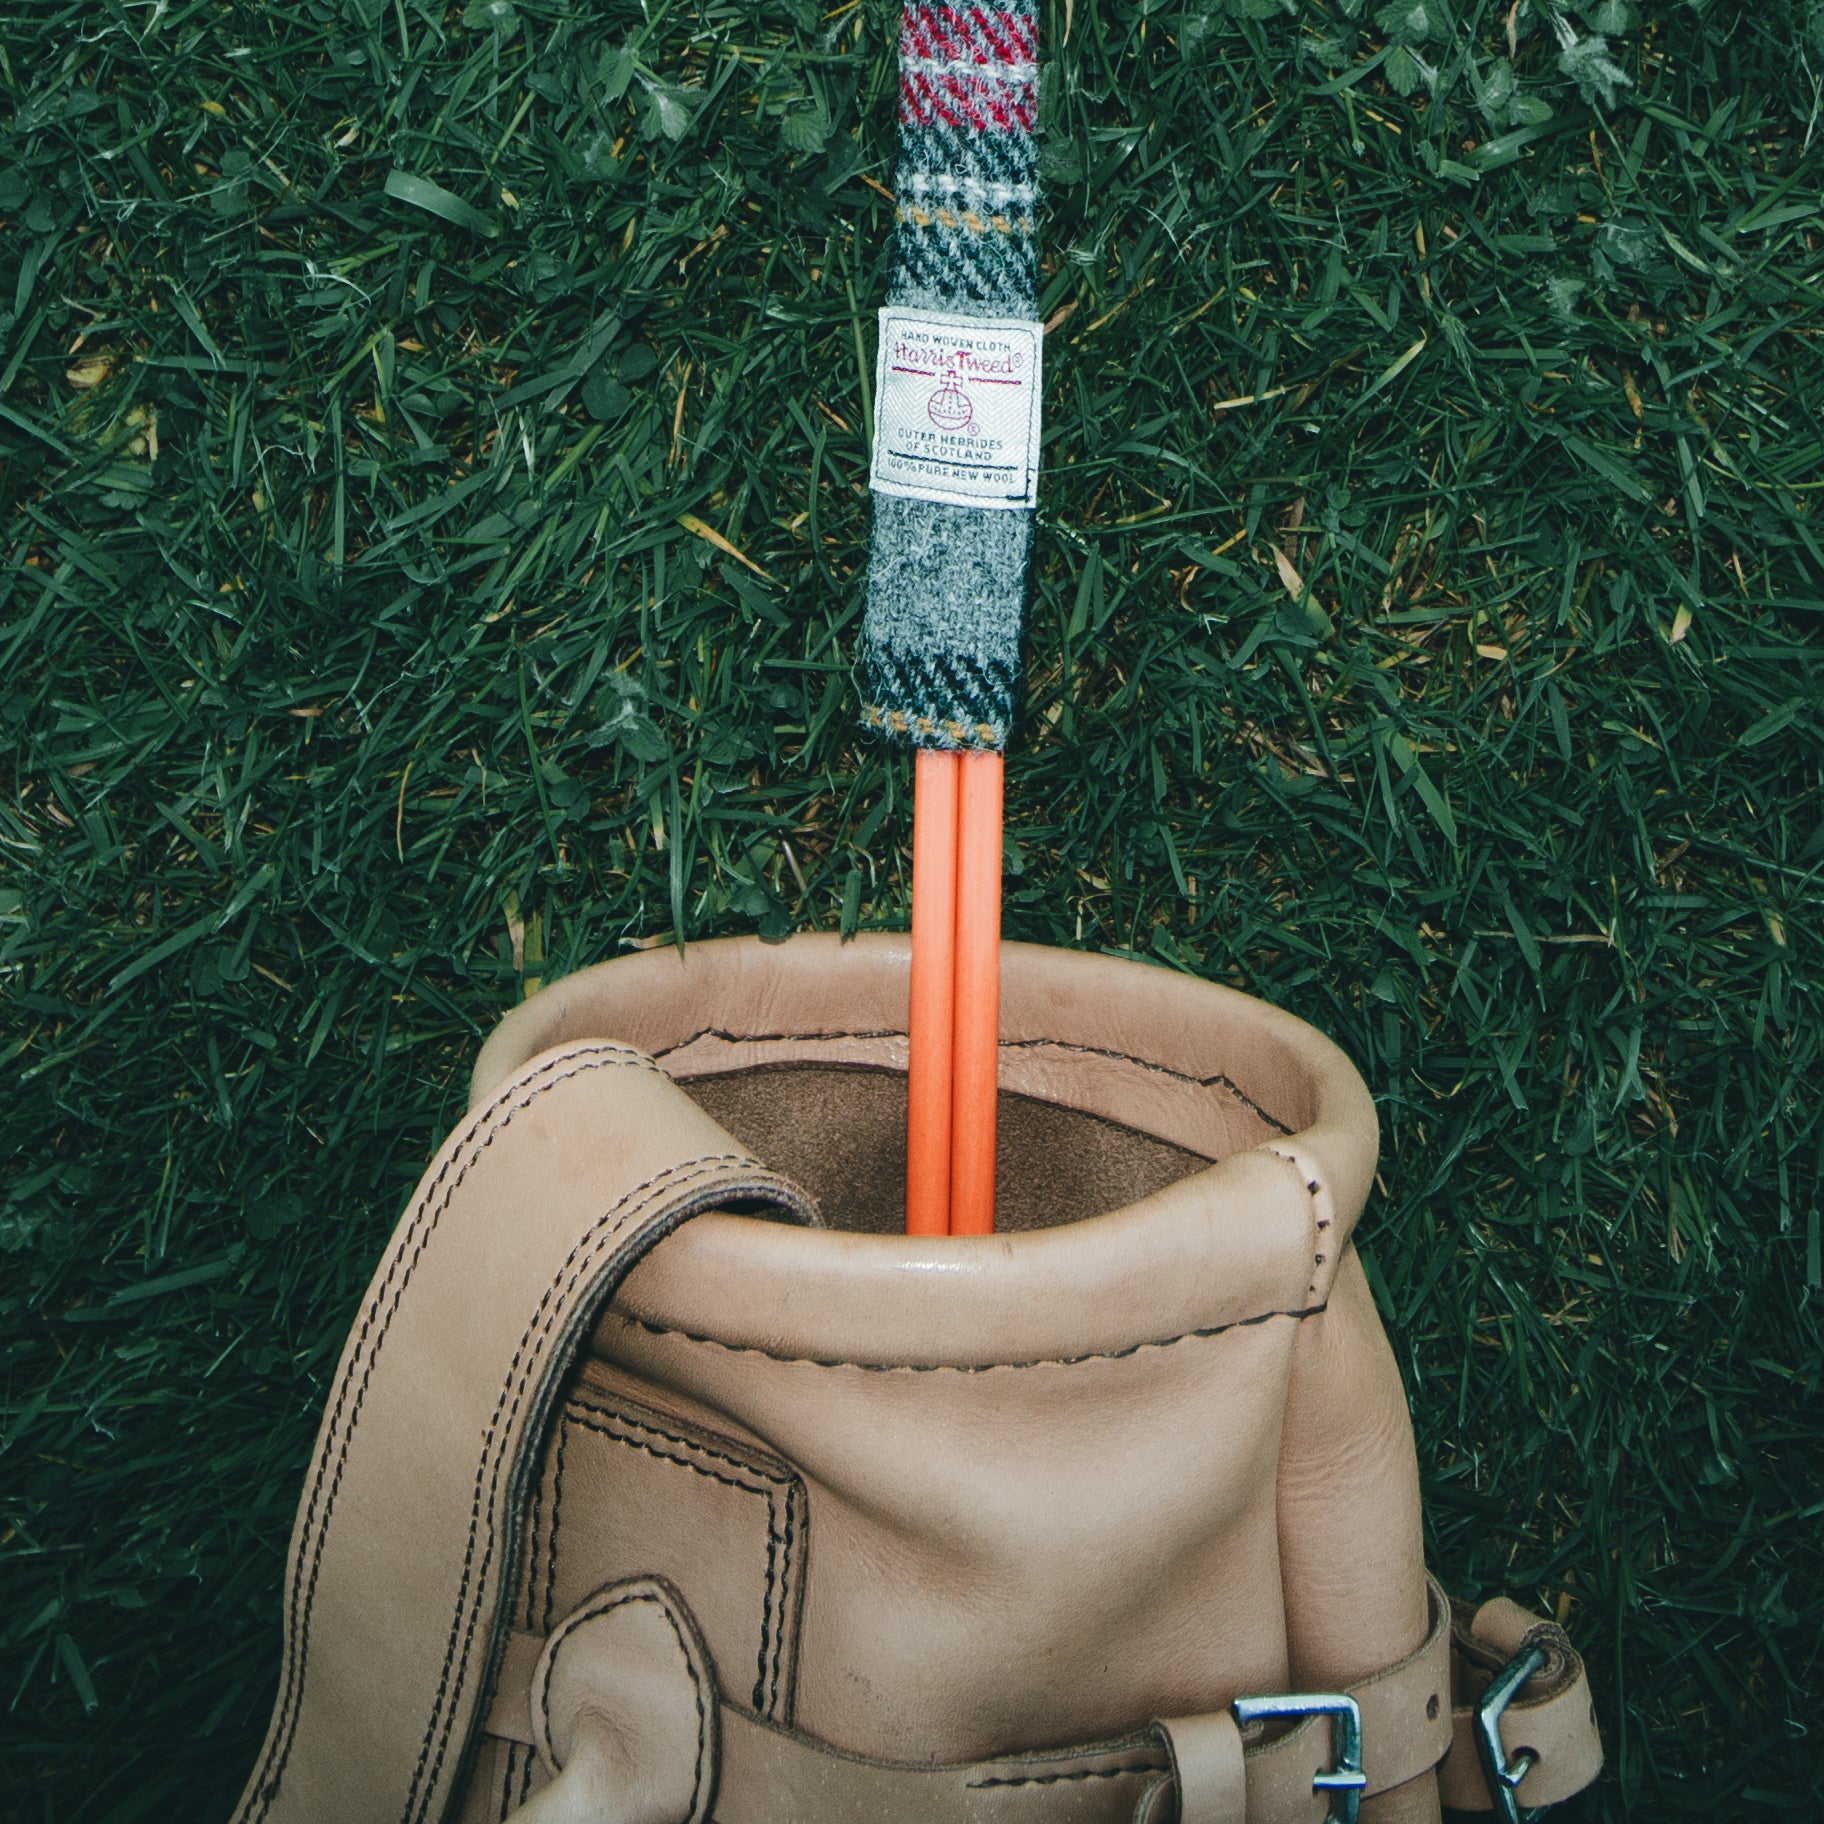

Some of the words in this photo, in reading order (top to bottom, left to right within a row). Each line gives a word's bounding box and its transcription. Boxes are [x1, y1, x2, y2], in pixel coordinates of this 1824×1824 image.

[902, 330, 929, 343] HAND
[933, 335, 973, 349] WOVEN
[976, 341, 1011, 352] CLOTH
[895, 341, 955, 368] Harris
[898, 428, 936, 442] OUTER
[941, 435, 1003, 450] HEBRIDES
[906, 441, 920, 451] OF
[924, 444, 992, 461] SCOTLAND
[918, 463, 950, 477] PURE
[952, 470, 979, 481] NEW
[983, 472, 1016, 484] WOOL
